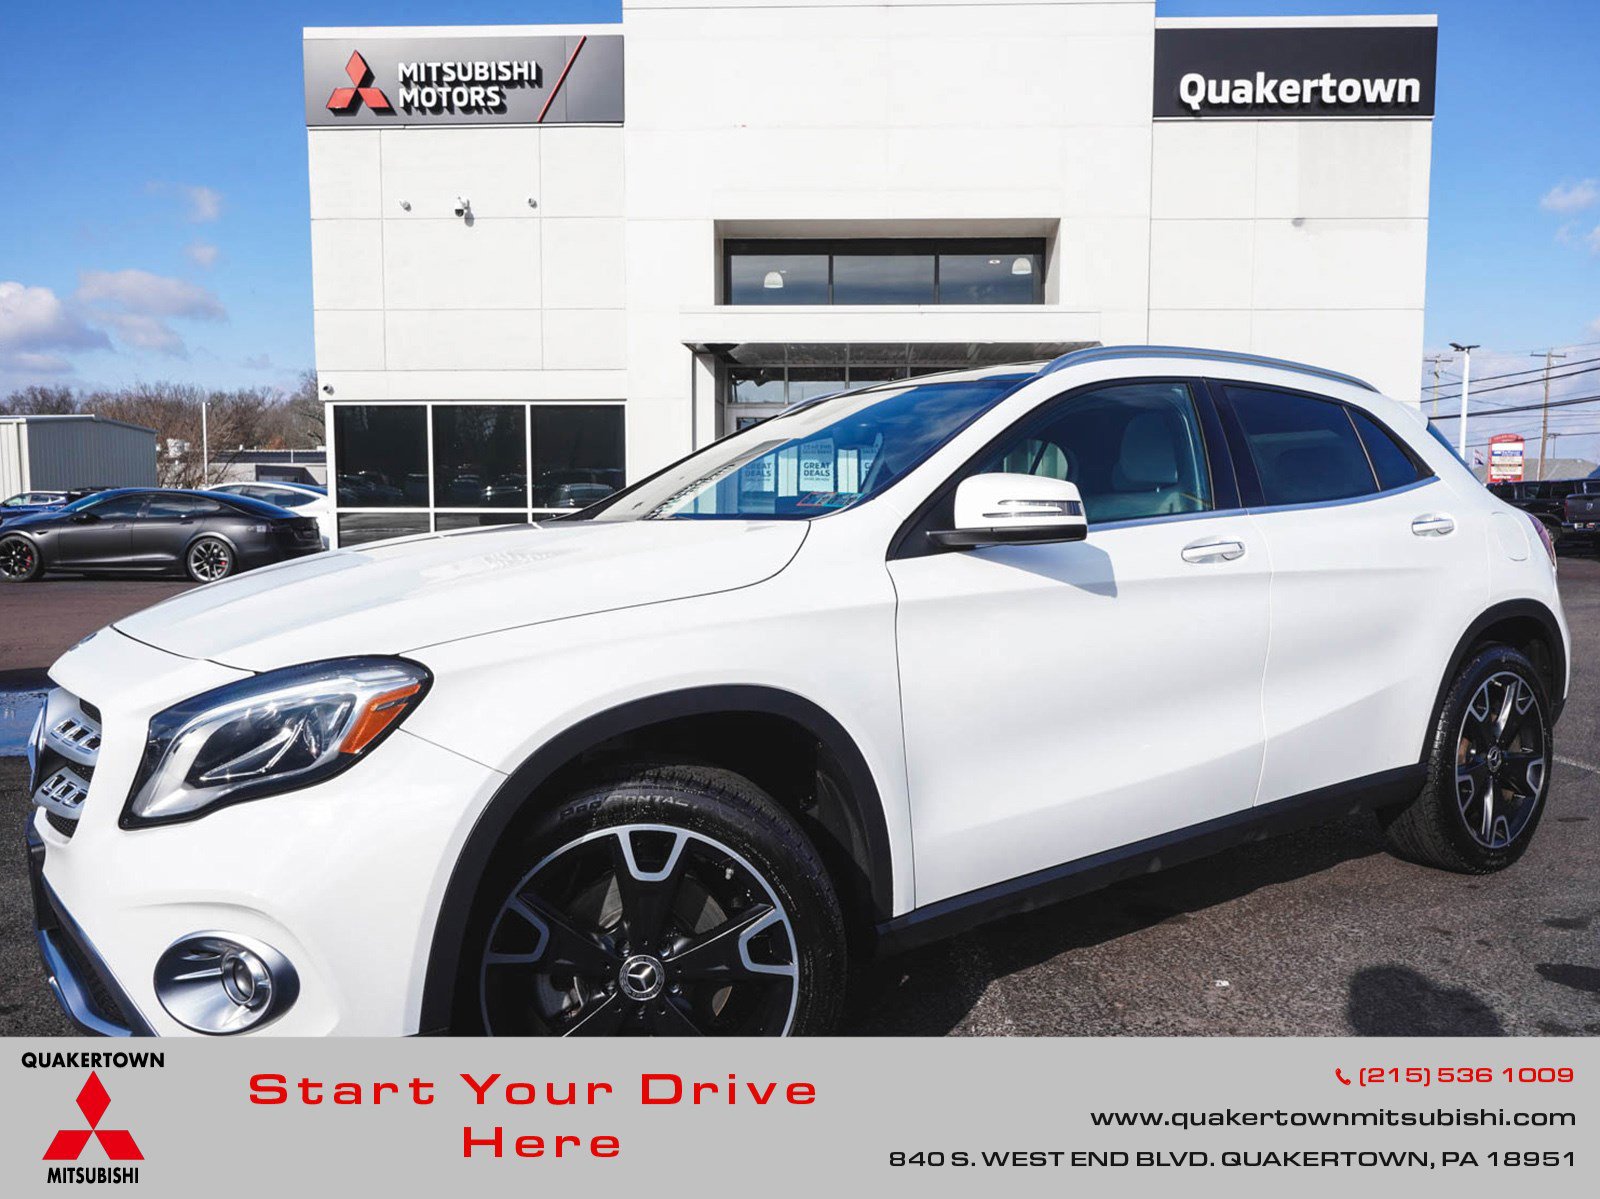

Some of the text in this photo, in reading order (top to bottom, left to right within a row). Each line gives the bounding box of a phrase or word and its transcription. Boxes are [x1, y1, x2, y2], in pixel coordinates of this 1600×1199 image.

[398, 60, 538, 83] MITSUBISHI
[398, 86, 502, 108] MOTORS
[1179, 71, 1421, 111] Quakertown
[803, 469, 831, 477] DEALS
